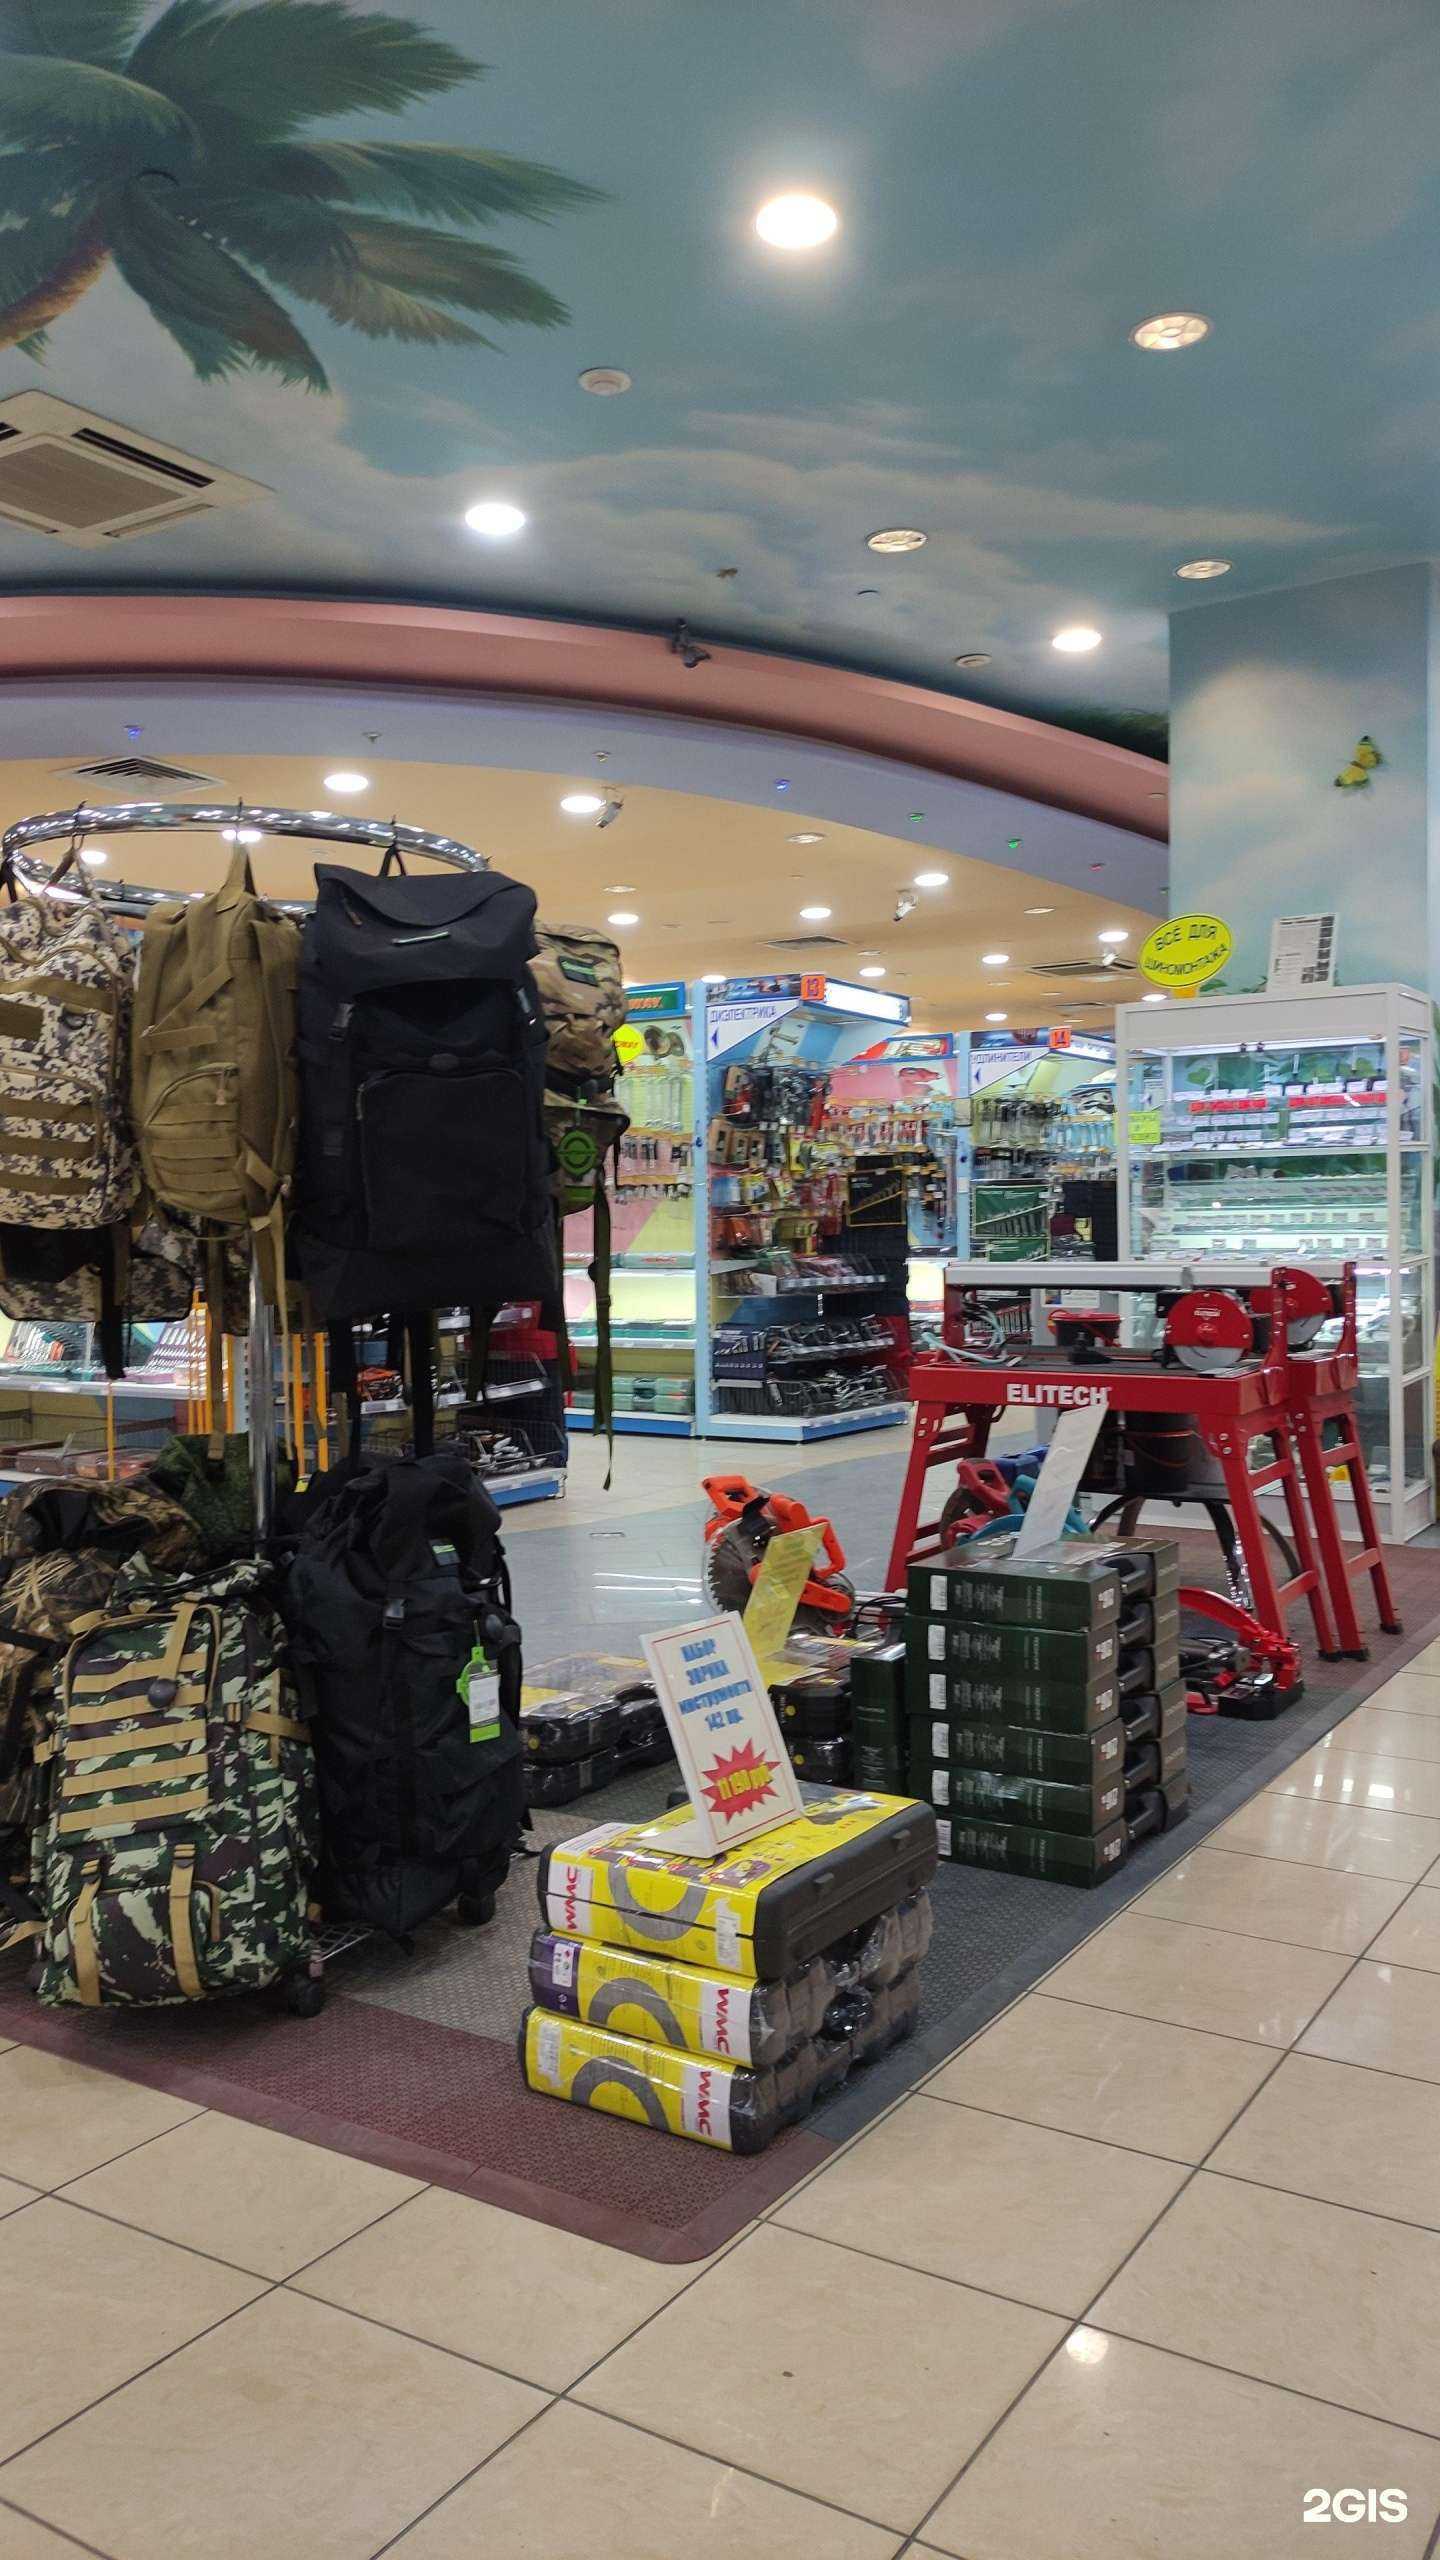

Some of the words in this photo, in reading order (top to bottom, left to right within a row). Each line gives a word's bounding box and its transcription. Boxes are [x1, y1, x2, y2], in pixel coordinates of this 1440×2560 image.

[1188, 924, 1217, 941] ДЛЯ
[1007, 1383, 1110, 1406] ELITECH
[714, 1988, 731, 2055] WMC
[697, 2071, 712, 2137] WMC
